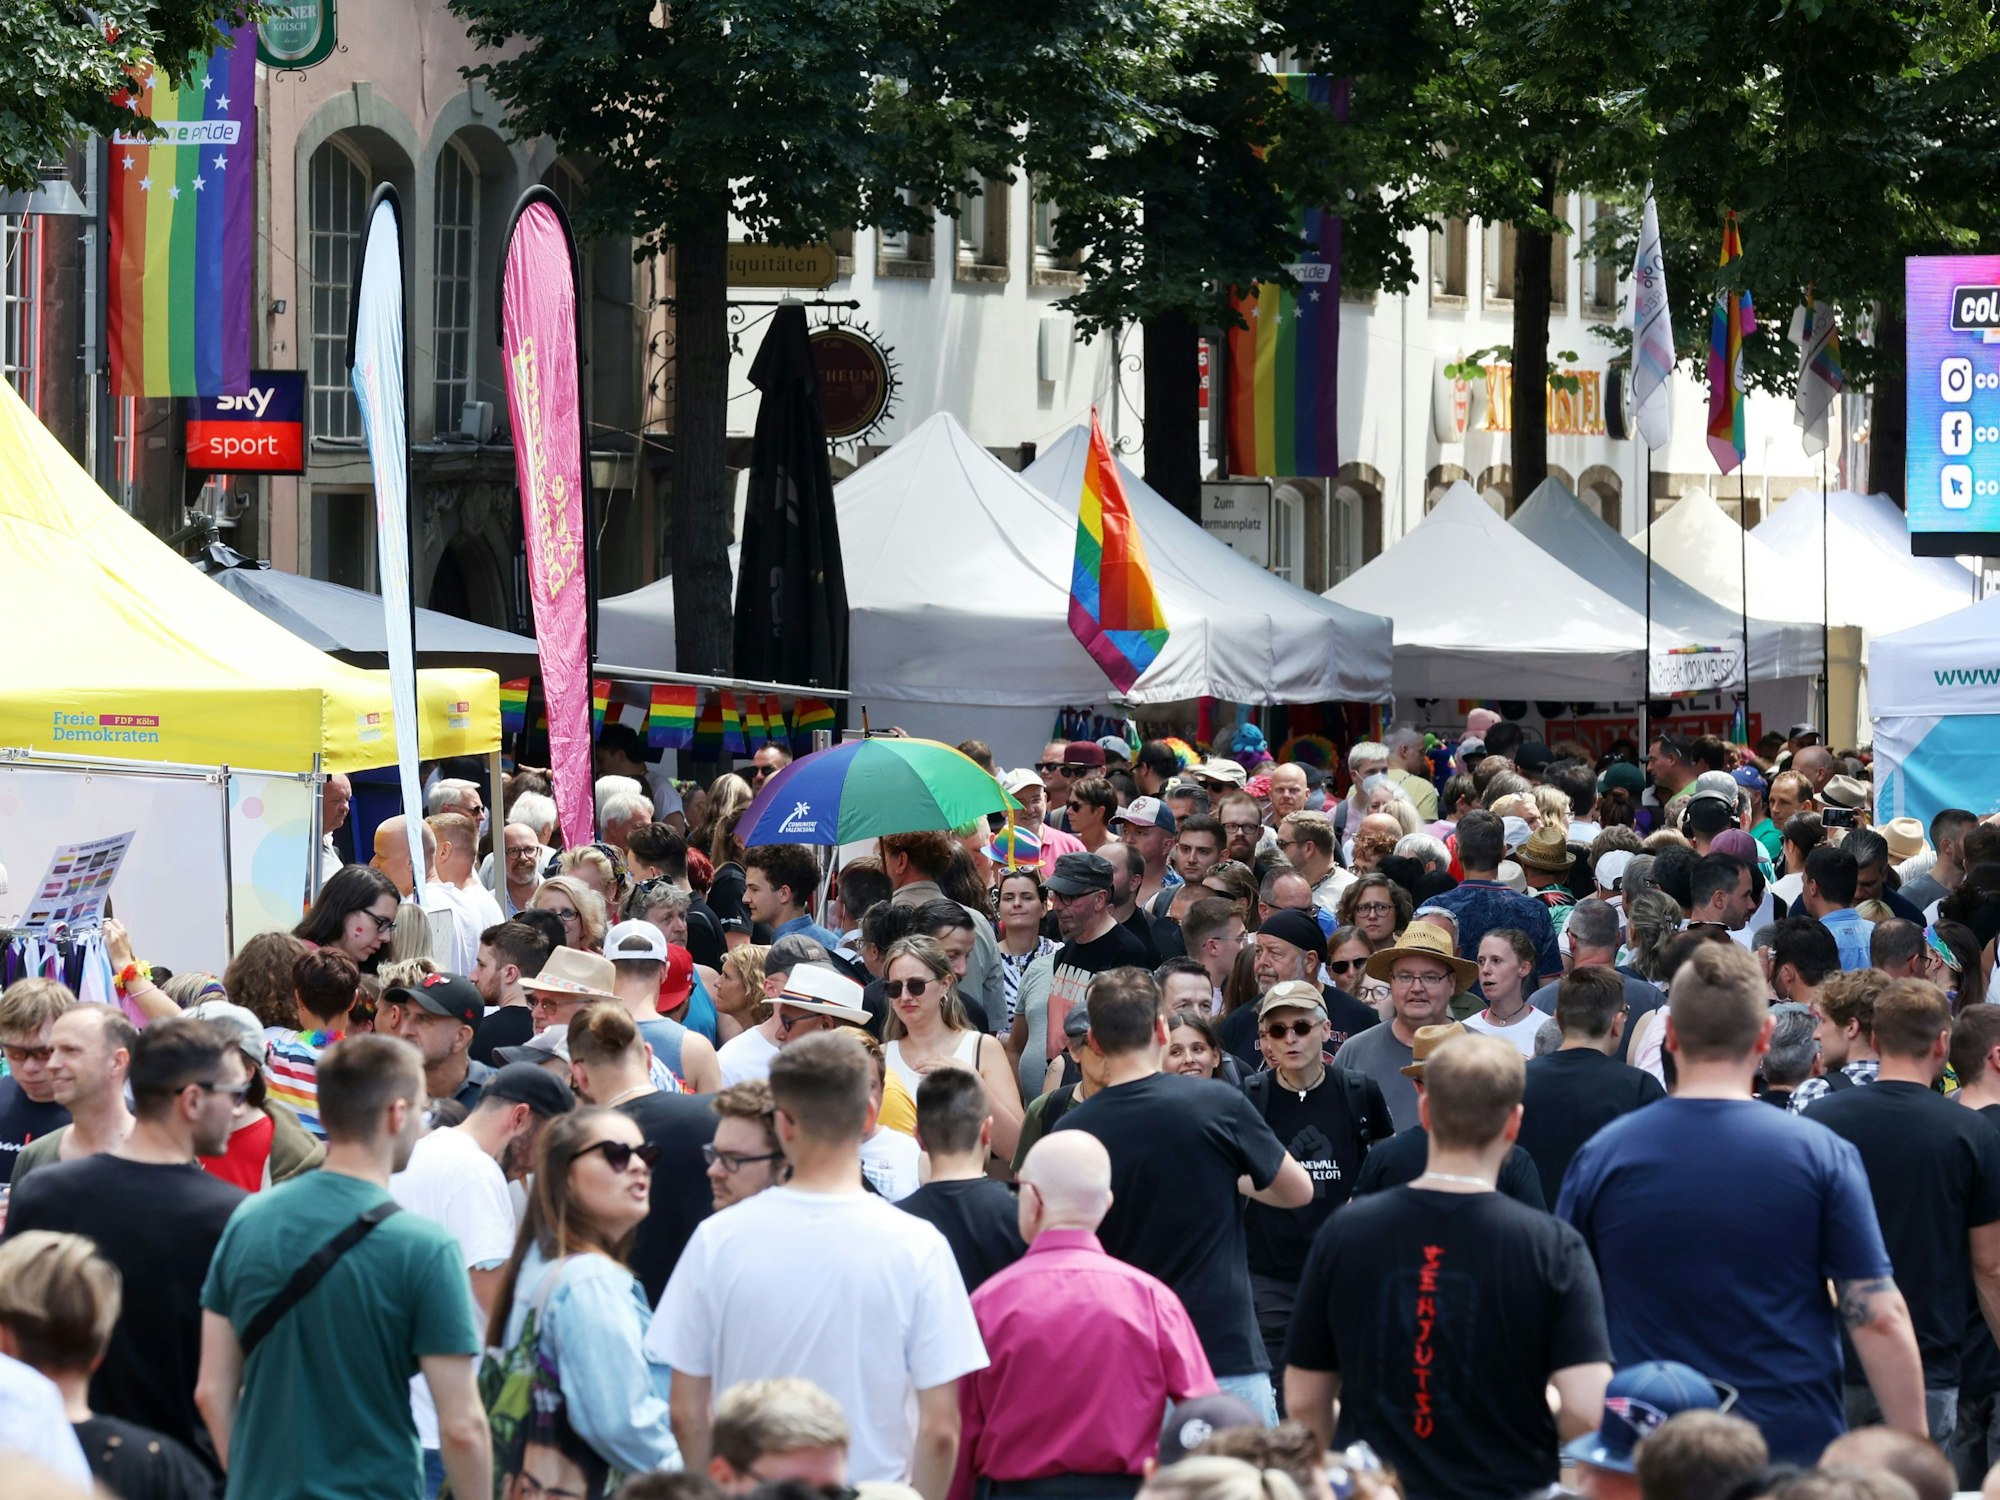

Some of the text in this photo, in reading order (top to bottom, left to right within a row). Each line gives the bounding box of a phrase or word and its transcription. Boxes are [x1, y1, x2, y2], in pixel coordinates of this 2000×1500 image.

[191, 123, 234, 140] pride
[1975, 372, 2000, 389] co
[1975, 425, 2000, 443] co
[210, 436, 278, 458] sport
[1975, 479, 2000, 496] co
[1214, 495, 1234, 509] Zum
[53, 711, 95, 725] Freie
[114, 716, 133, 725] FDP
[53, 727, 159, 743] Demokraten
[1312, 1170, 1341, 1180] RIOT!
[1412, 1245, 1447, 1439] SENJUTSU
